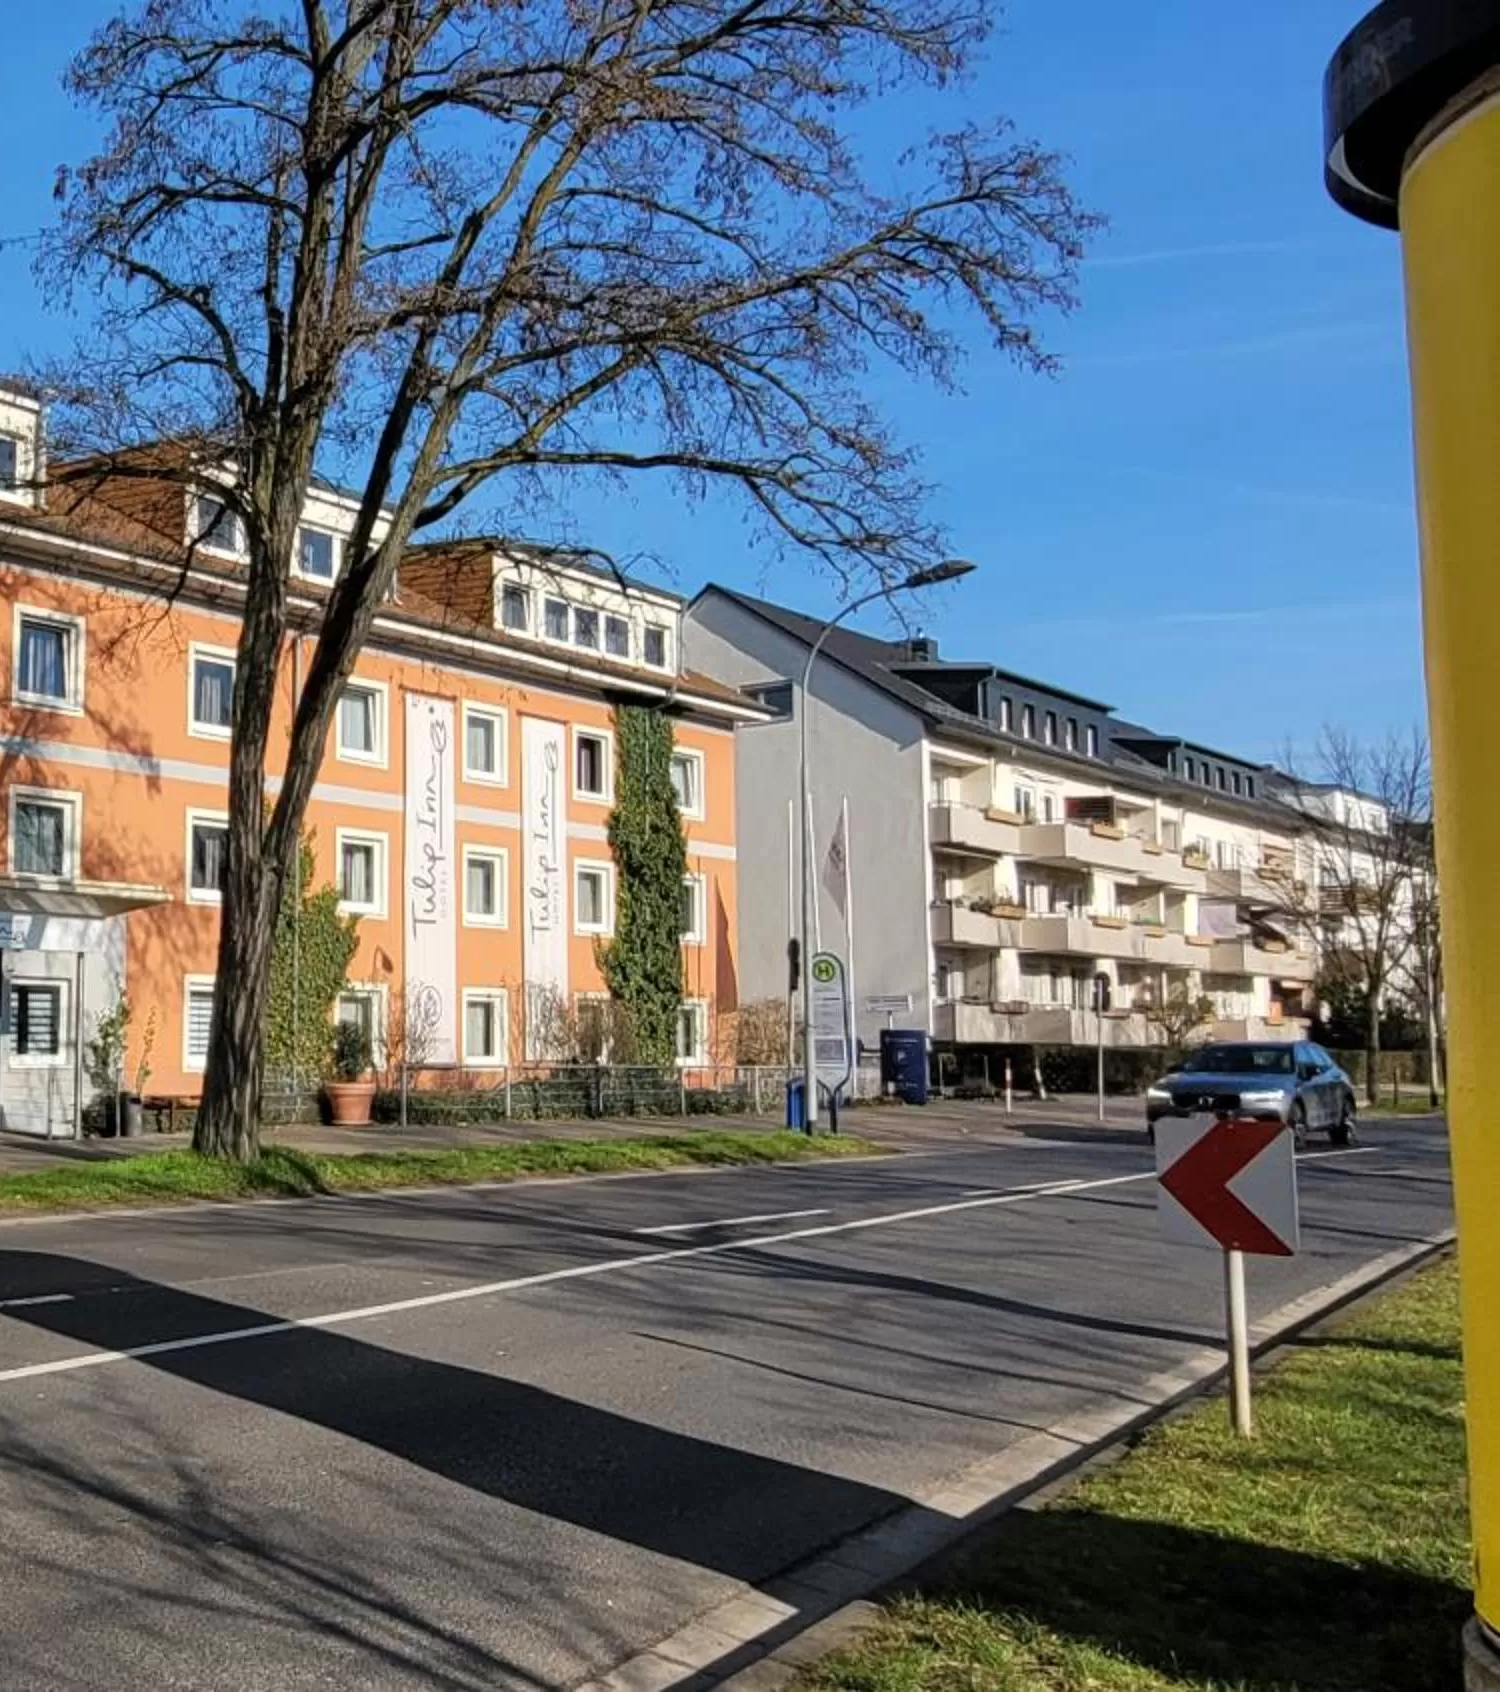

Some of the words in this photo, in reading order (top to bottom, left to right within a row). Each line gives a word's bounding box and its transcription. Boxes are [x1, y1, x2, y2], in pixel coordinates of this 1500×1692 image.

[416, 755, 437, 834] Inn
[533, 772, 549, 841] Inn
[411, 843, 446, 942] Tulip
[530, 855, 559, 944] Tulip
[817, 965, 830, 976] H
